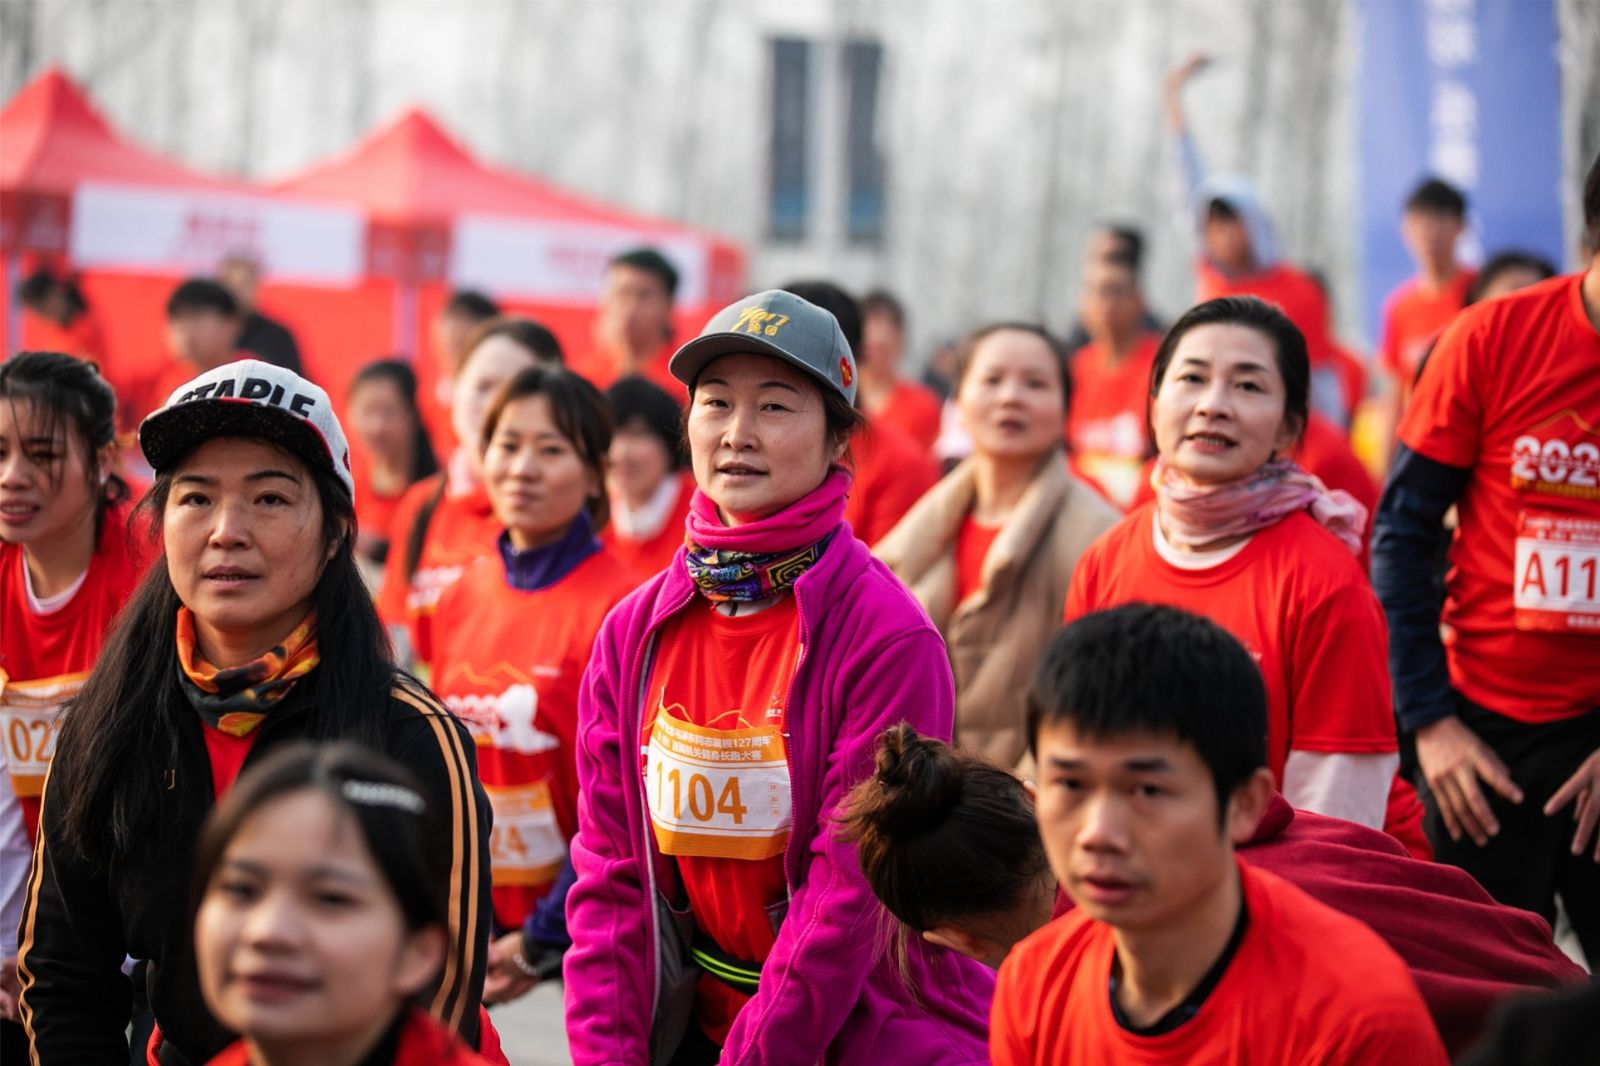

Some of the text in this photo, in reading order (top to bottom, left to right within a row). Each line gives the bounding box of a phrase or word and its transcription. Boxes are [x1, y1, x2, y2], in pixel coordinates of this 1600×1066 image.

[1521, 551, 1597, 600] A11
[8, 718, 64, 762] 02
[656, 761, 747, 825] 1104
